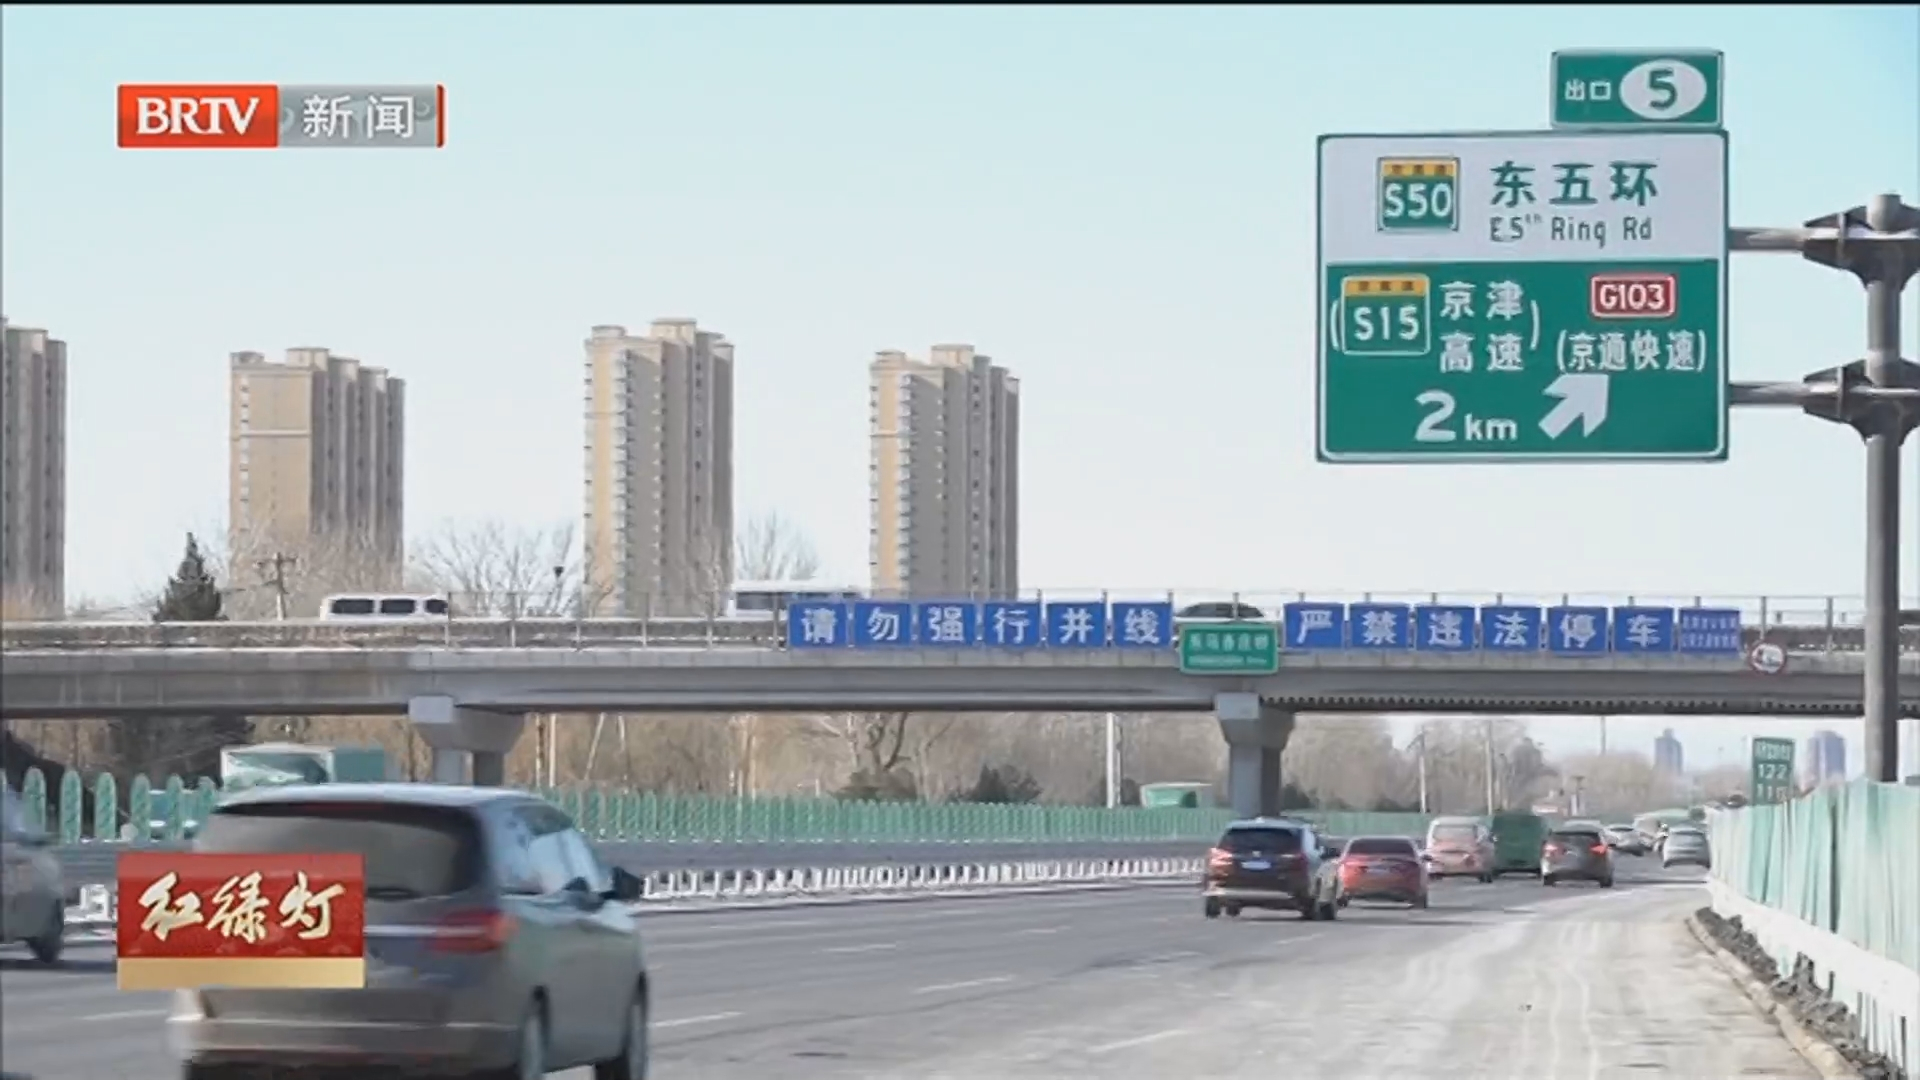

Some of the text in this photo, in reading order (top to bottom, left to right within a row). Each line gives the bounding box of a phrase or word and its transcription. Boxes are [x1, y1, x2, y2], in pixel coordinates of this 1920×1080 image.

[1564, 78, 1612, 101] 出口
[1647, 67, 1679, 110] 5
[1384, 182, 1453, 218] S50
[1489, 159, 1658, 208] 东五环
[1550, 216, 1606, 248] Ring
[1623, 216, 1652, 241] Rd
[1598, 283, 1666, 312] G103
[1439, 332, 1524, 373] 高速
[1414, 388, 1518, 442] 2 km
[801, 607, 1161, 645] 请勿强行并线
[1296, 609, 1662, 649] 严禁违法停车
